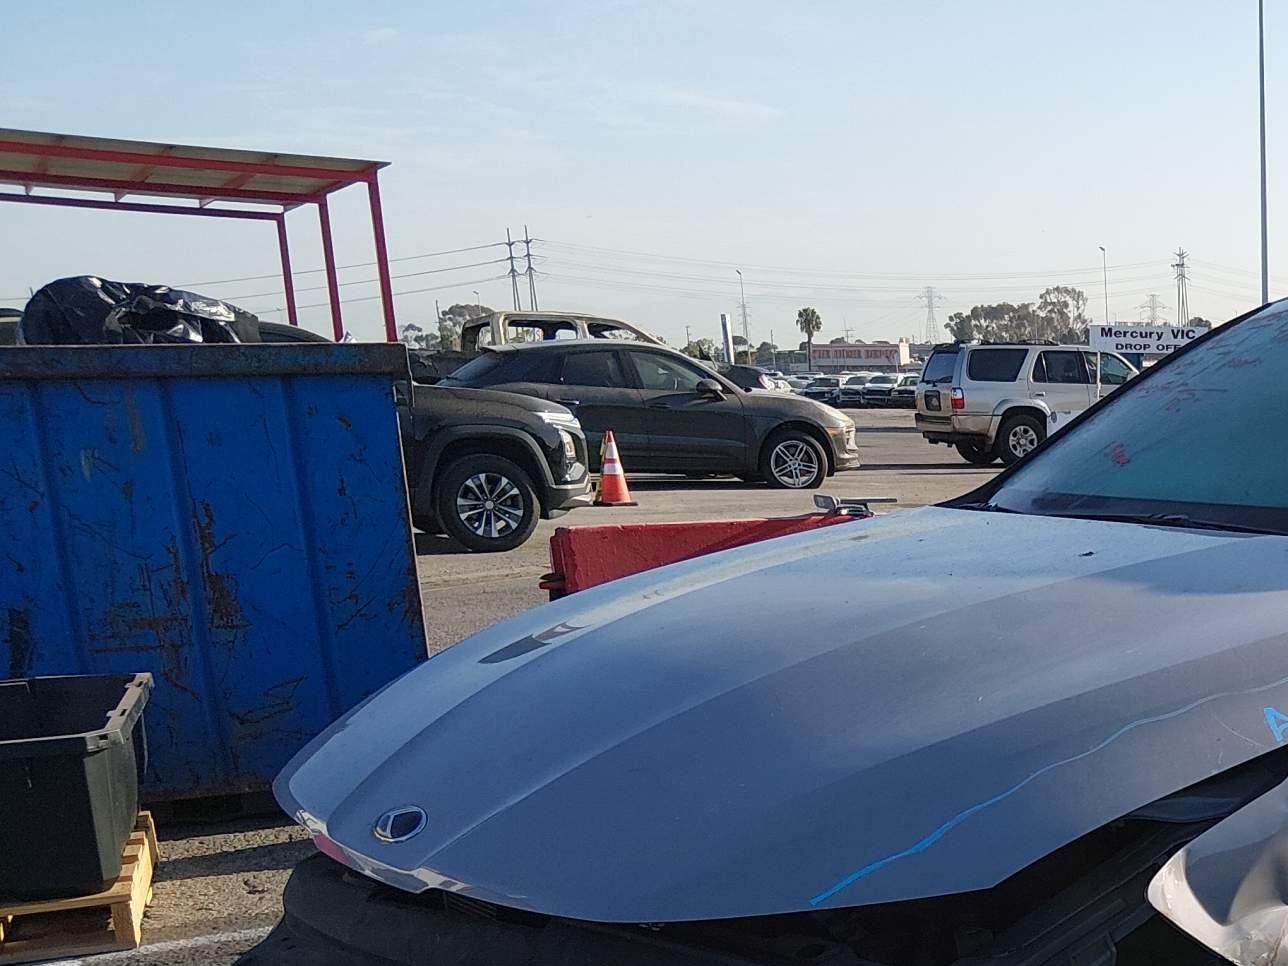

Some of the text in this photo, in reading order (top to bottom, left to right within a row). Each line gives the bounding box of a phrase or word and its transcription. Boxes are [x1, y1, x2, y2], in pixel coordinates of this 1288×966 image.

[1100, 327, 1196, 341] Mercury VIC
[1115, 343, 1151, 351] DROP
